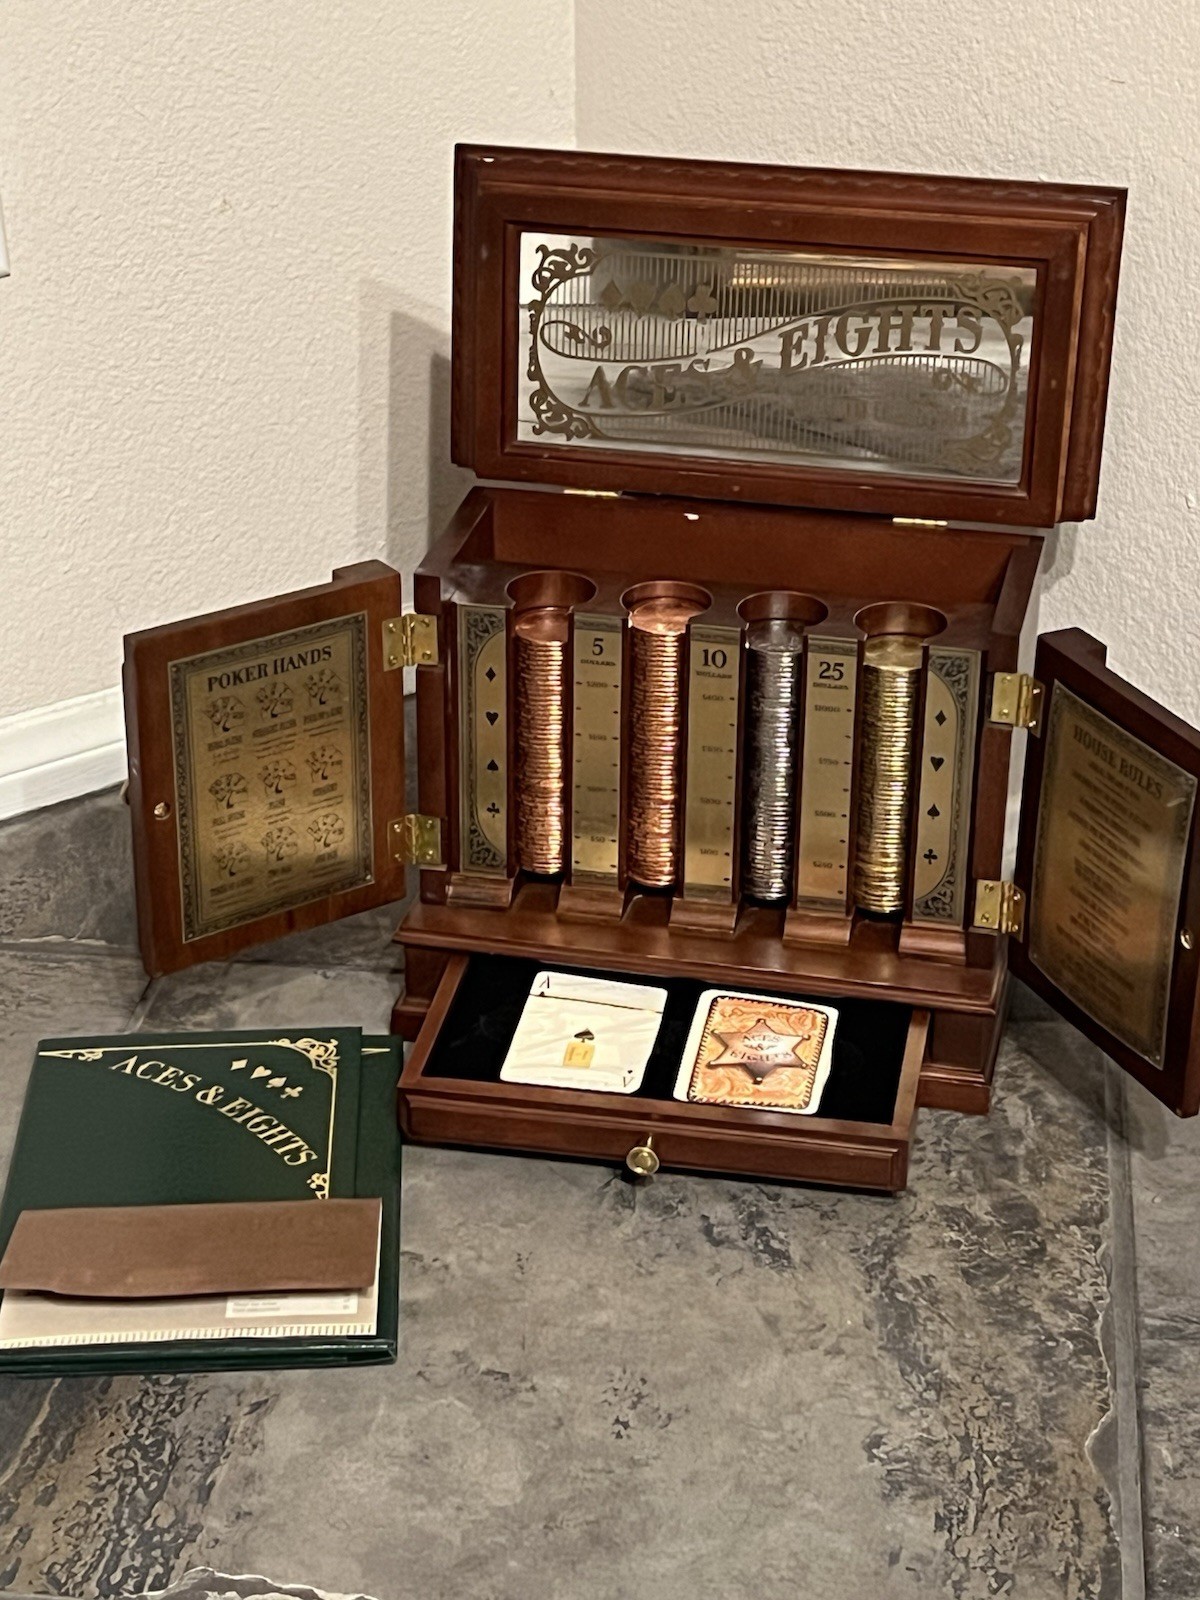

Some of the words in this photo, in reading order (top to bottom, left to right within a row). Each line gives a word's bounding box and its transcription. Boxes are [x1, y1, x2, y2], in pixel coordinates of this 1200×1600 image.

[779, 304, 984, 373] EIGHTS
[207, 663, 268, 693] POKER
[273, 645, 332, 676] HANDS
[591, 637, 604, 656] 5
[702, 649, 728, 669] 10
[818, 661, 844, 681] 25
[1073, 724, 1116, 769] HOUSE
[1119, 758, 1164, 799] RULES
[109, 1054, 202, 1092] ACES
[195, 1085, 224, 1105] &
[217, 1097, 319, 1167] EIGHTS
